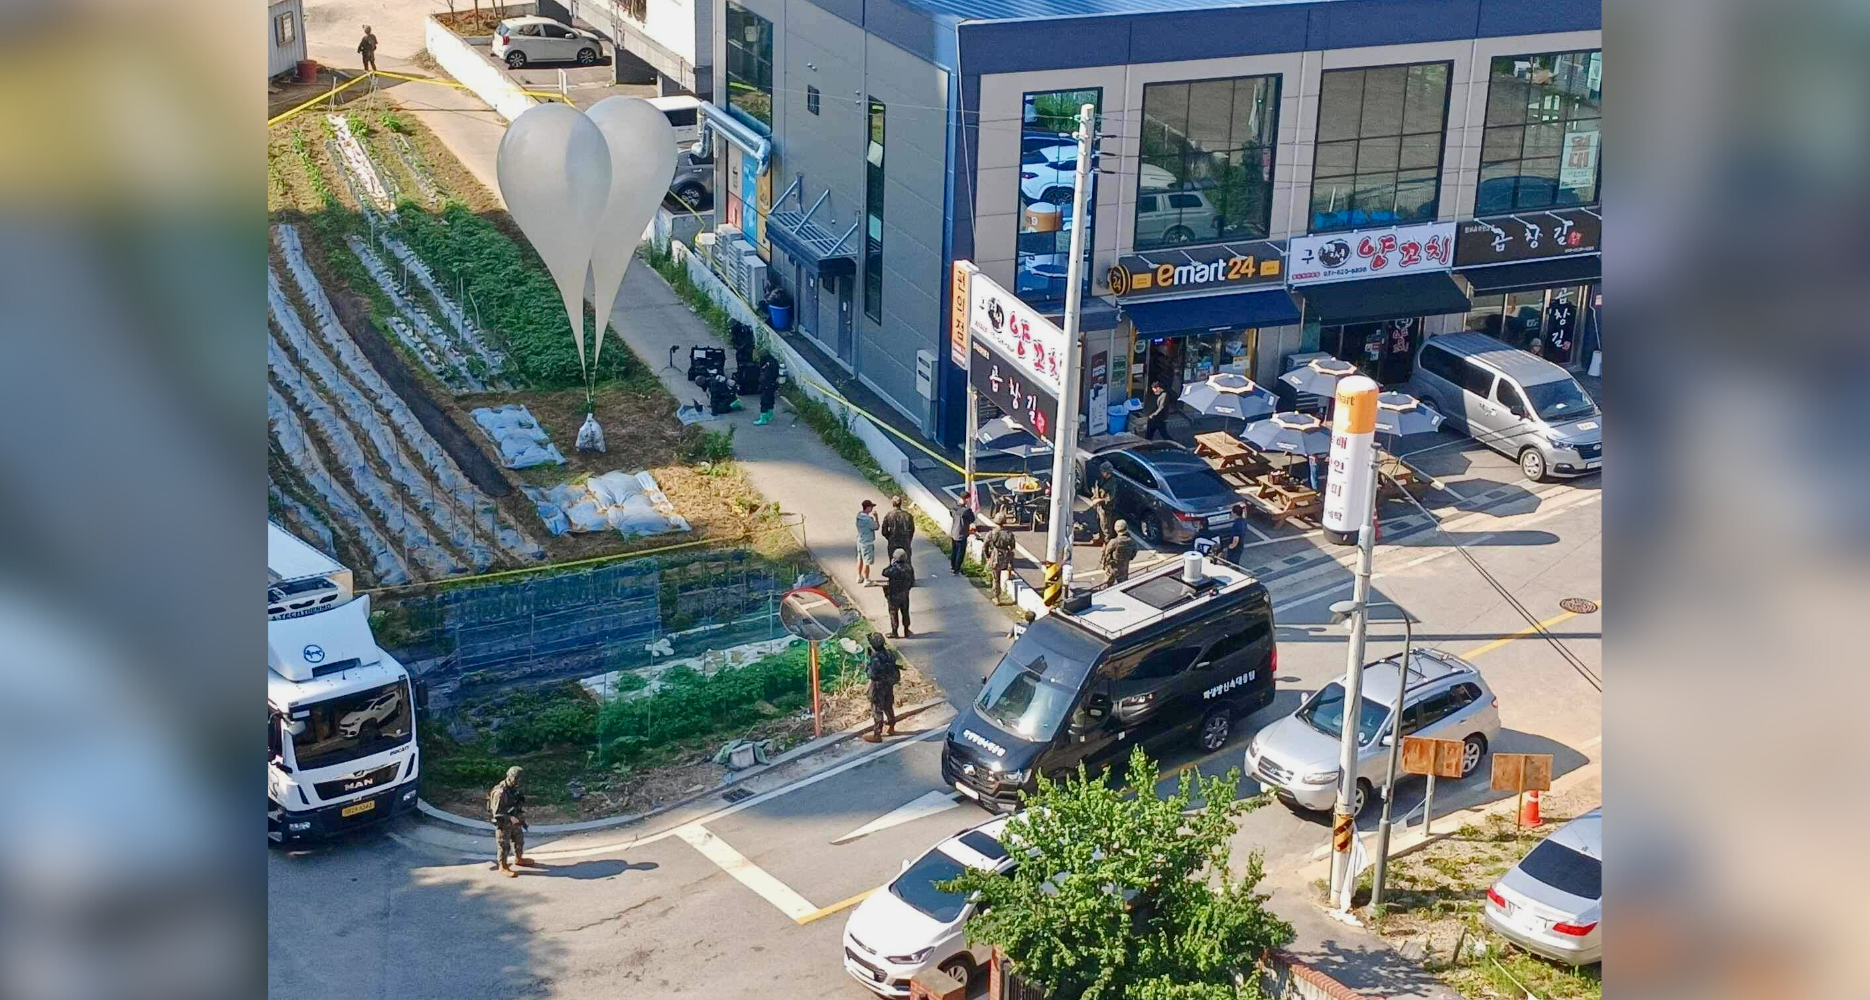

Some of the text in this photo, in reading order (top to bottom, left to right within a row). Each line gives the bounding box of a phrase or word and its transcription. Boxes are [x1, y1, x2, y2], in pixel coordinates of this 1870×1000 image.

[1301, 249, 1315, 264] 구
[1357, 234, 1452, 271] 양꼬치
[1156, 255, 1256, 288] emart24
[955, 269, 967, 343] 편의점
[344, 778, 373, 791] MAN
